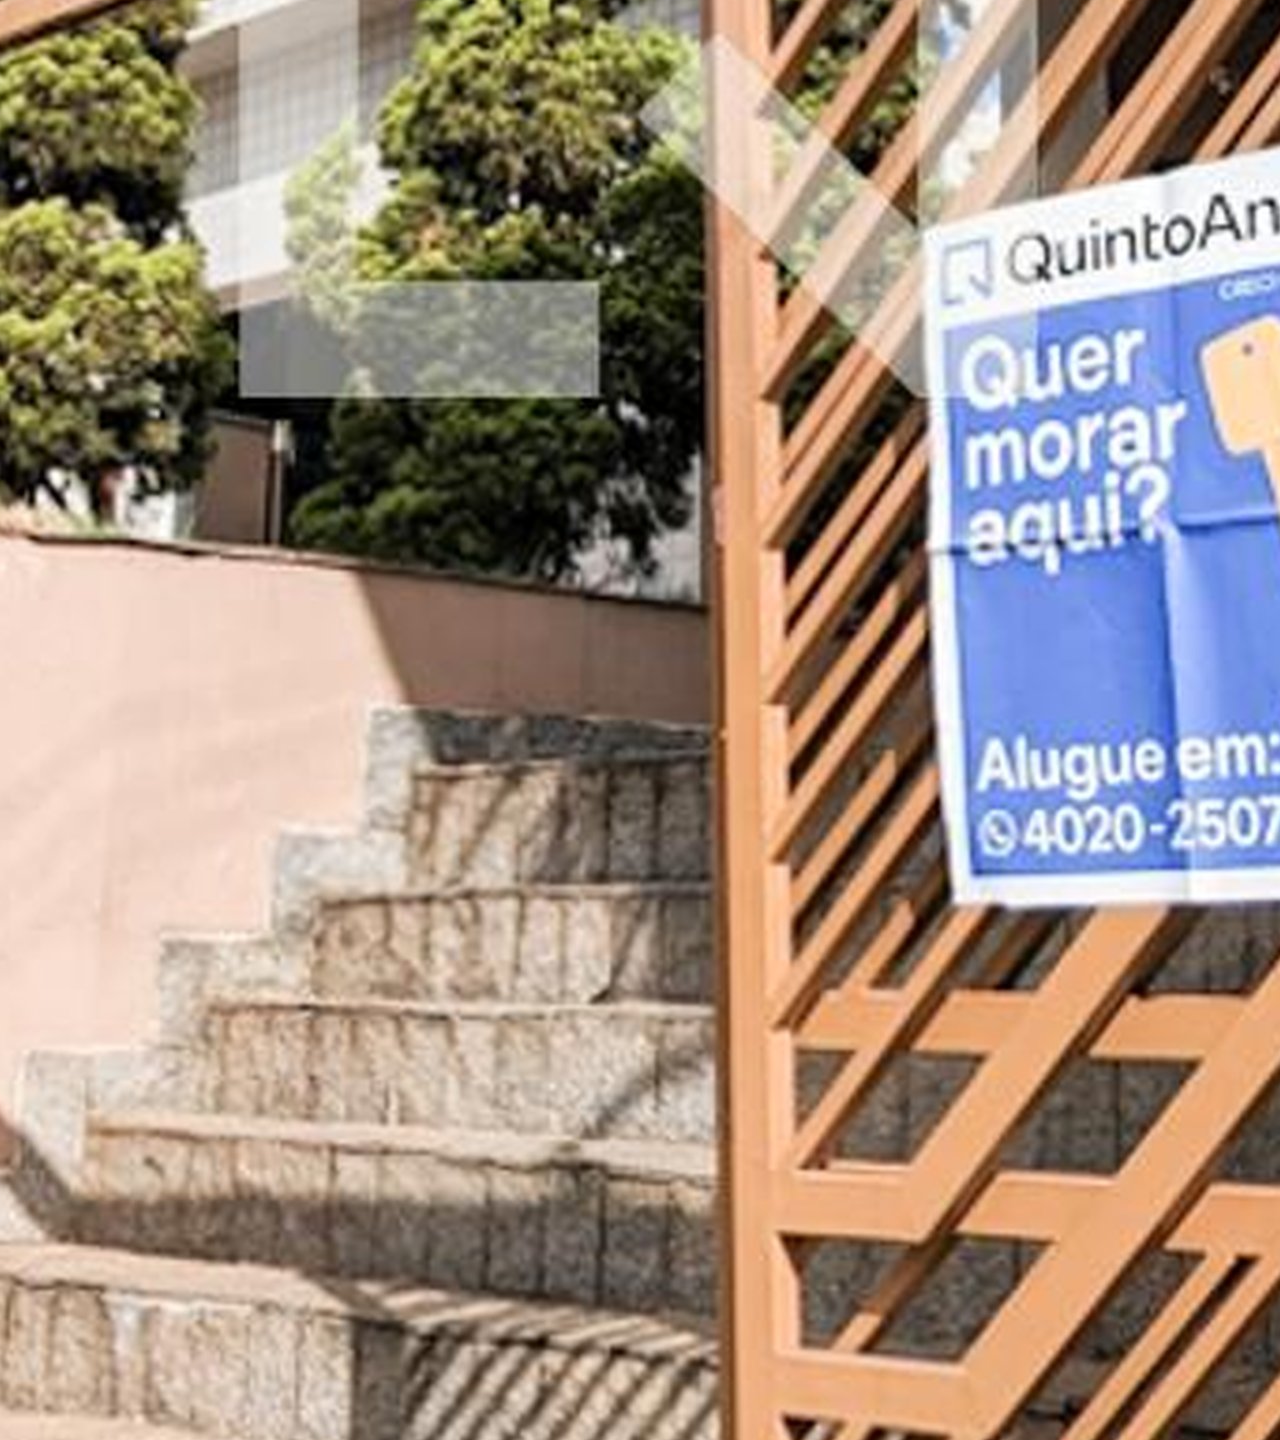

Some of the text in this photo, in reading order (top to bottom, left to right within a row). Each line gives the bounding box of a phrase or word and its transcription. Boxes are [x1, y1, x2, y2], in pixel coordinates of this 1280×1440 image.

[961, 328, 1145, 410] Quer
[966, 401, 1187, 490] morar
[966, 465, 1170, 575] aqui?
[975, 735, 1166, 801] Alugue
